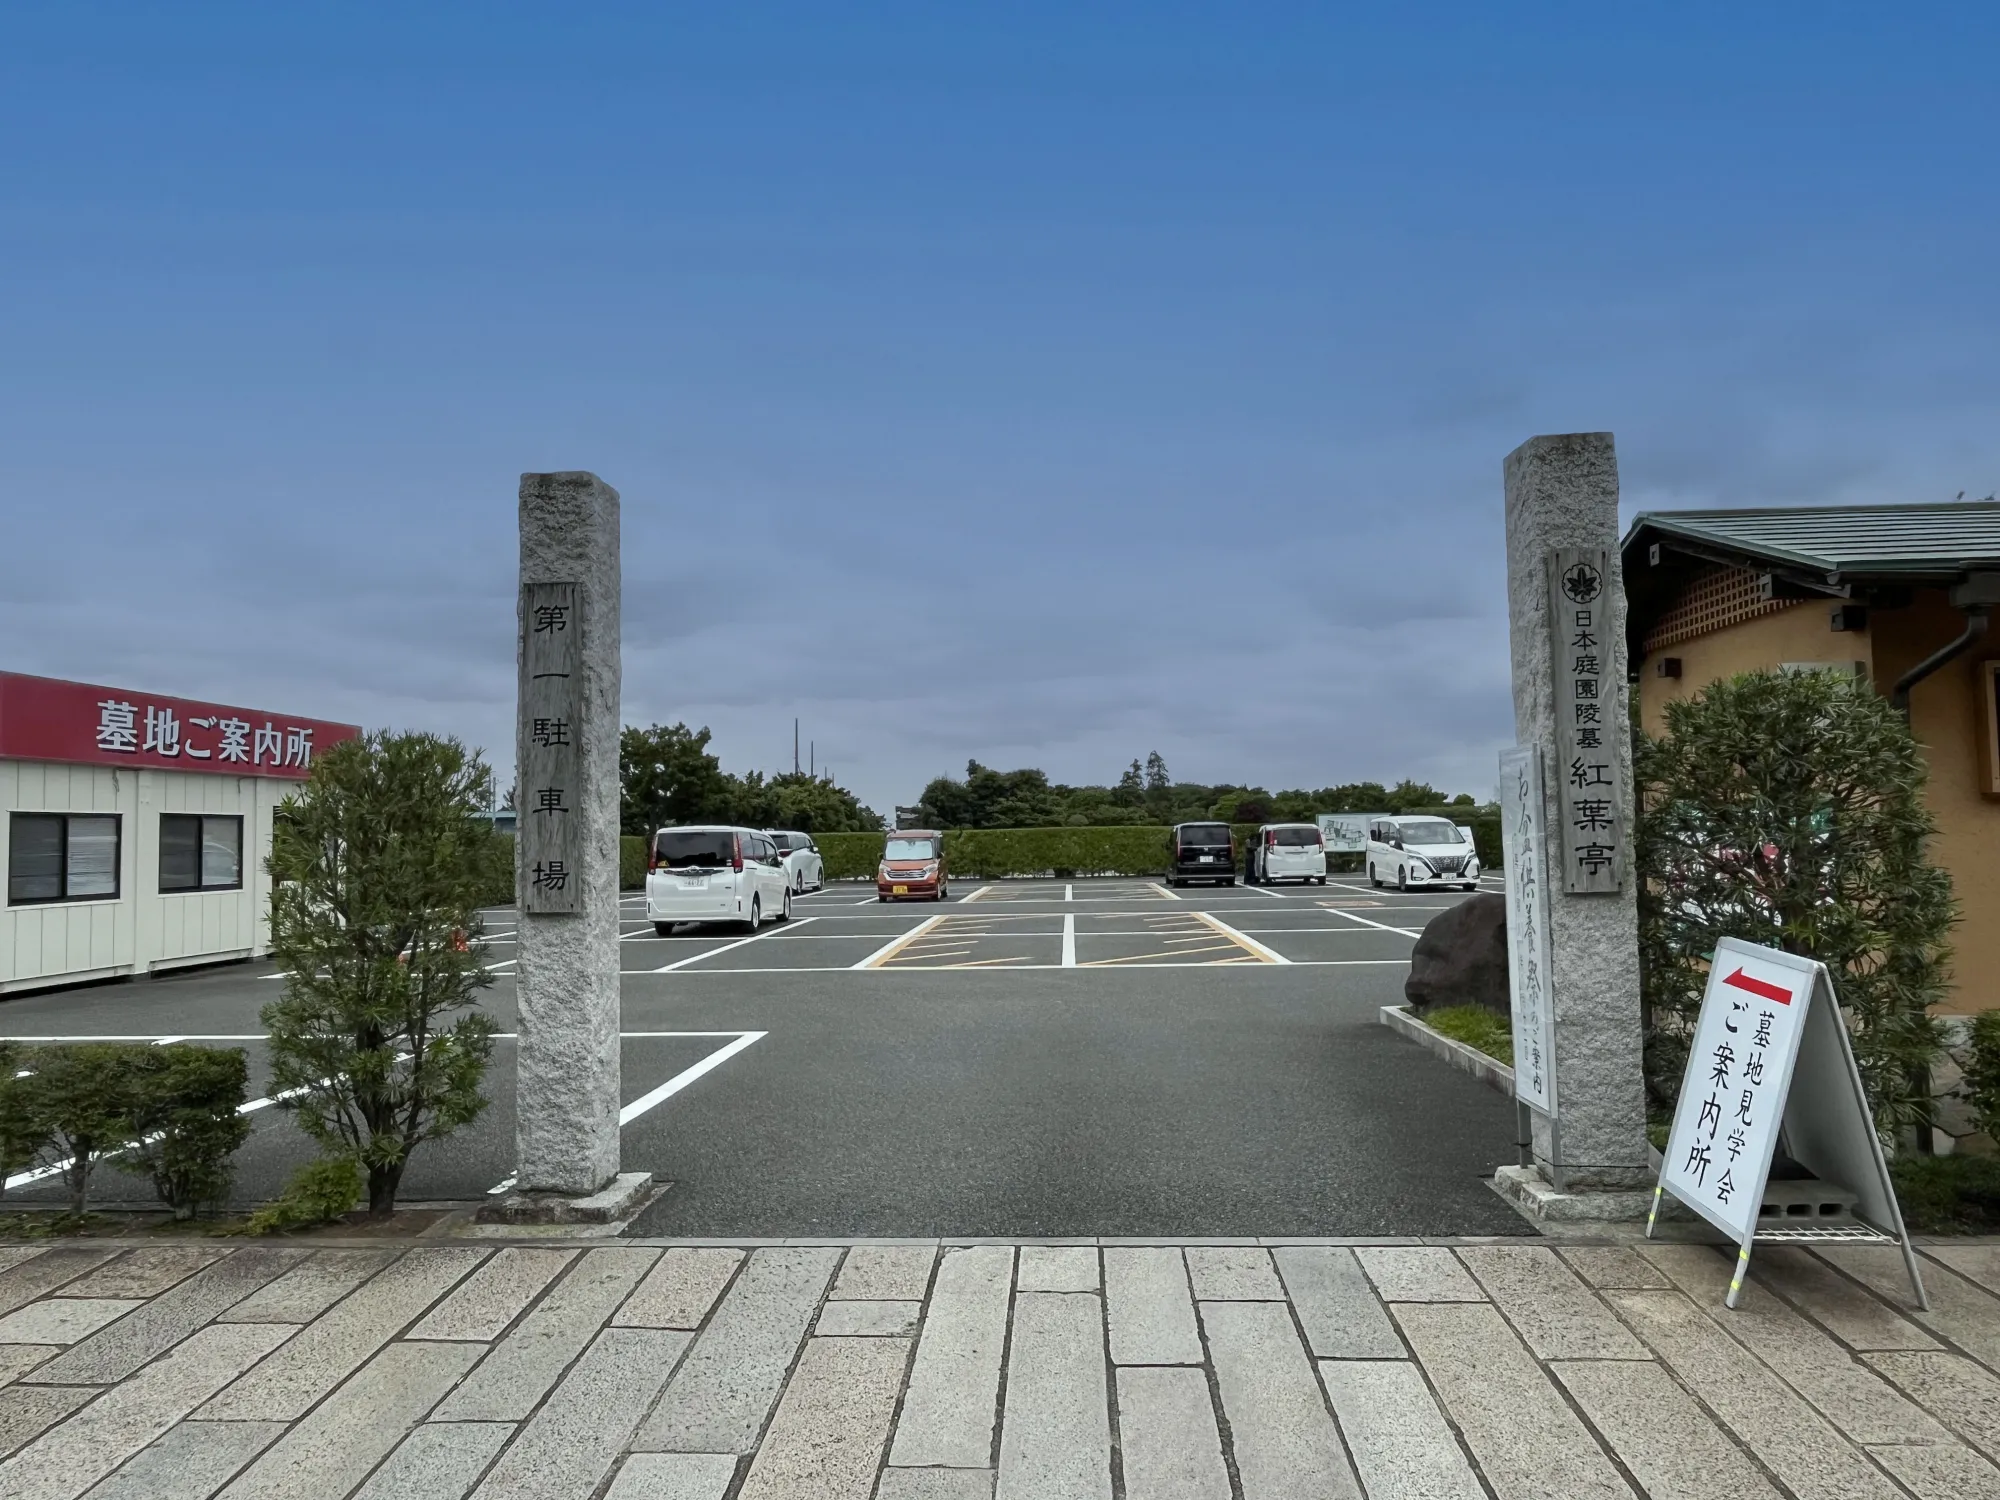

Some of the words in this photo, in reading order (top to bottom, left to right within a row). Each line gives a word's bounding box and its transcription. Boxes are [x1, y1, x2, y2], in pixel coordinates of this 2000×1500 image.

[96, 699, 314, 769] 墓地ご案内所
[531, 604, 570, 891] 第一駐車場
[1569, 755, 1614, 876] 紅葉亭
[1683, 1001, 1750, 1189] ご案内所
[1716, 1010, 1776, 1206] 墓地見学会
